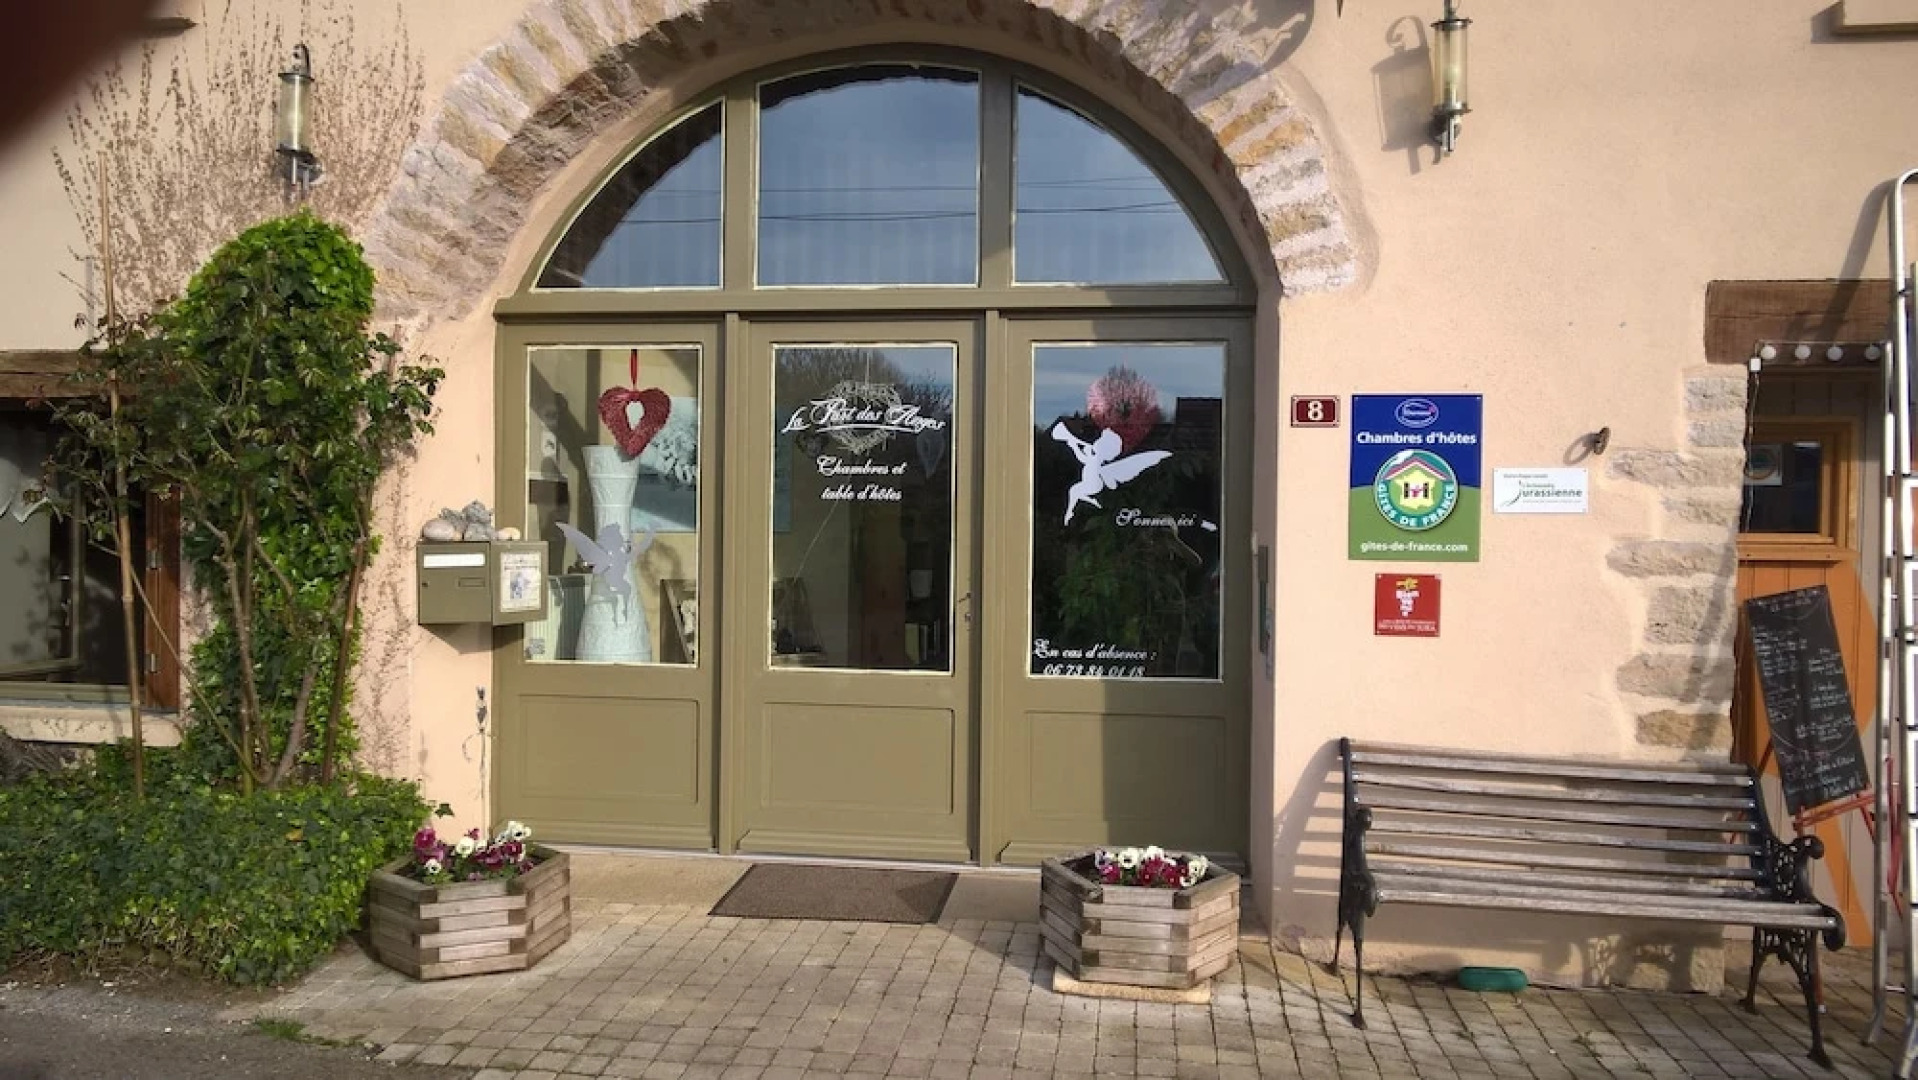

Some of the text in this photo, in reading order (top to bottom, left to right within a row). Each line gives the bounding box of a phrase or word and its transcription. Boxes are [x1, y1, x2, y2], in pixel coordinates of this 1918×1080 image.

[855, 405, 884, 421] des
[1307, 401, 1324, 421] 8
[1356, 431, 1478, 445] Chambres d'hôtes
[816, 454, 909, 477] Chambres et
[820, 482, 902, 500] table d'hôtes
[1399, 516, 1418, 527] DE
[1422, 484, 1455, 527] FRANCE
[1176, 513, 1198, 527] ici
[1033, 638, 1059, 660] En
[1062, 649, 1083, 660] cas
[1085, 642, 1148, 661] d'absence
[1043, 663, 1064, 677] 06
